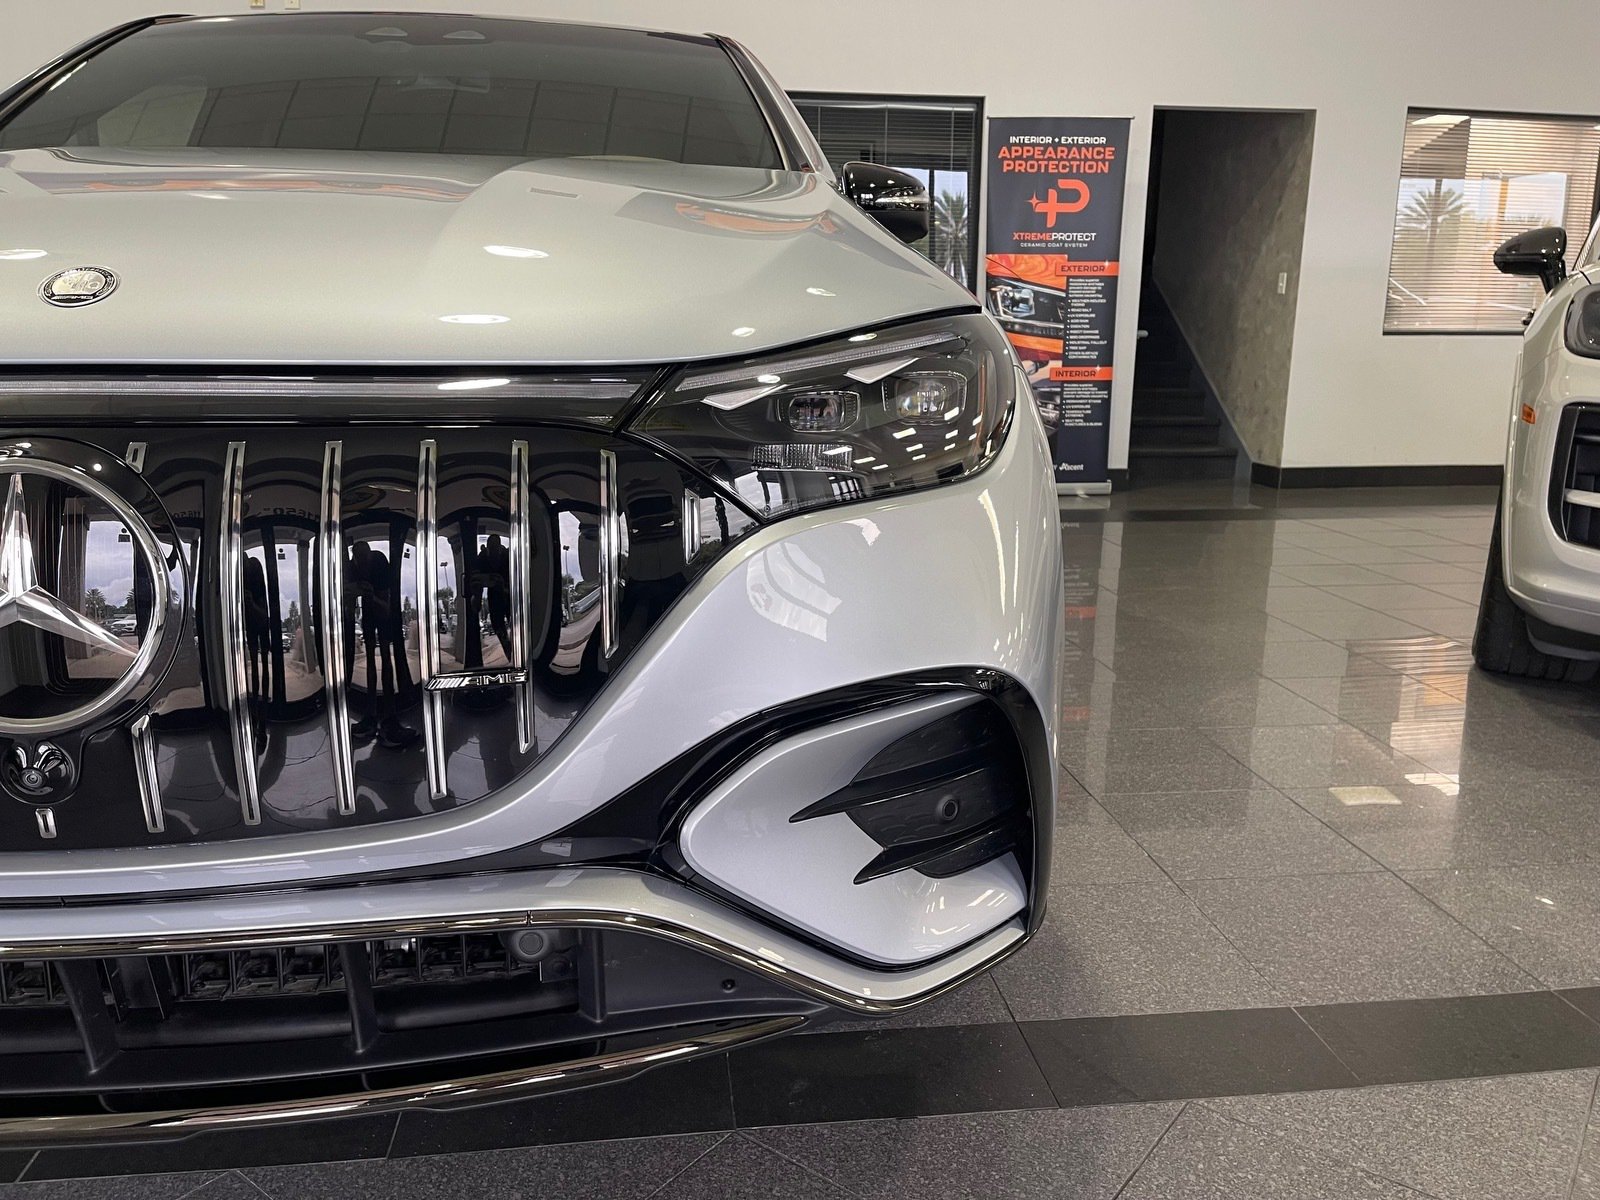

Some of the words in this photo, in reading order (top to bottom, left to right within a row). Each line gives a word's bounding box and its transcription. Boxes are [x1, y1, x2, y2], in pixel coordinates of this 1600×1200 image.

[1009, 136, 1053, 144] INTERIOR
[1061, 136, 1107, 145] EXTERIOR
[998, 146, 1116, 160] APPEARANCE
[1002, 160, 1109, 174] PROTECTION
[1012, 232, 1097, 241] XTREMEPROTECT
[1060, 264, 1105, 272] EXTERIOR
[1055, 370, 1096, 378] INTERIOR
[458, 672, 526, 687] AMG
